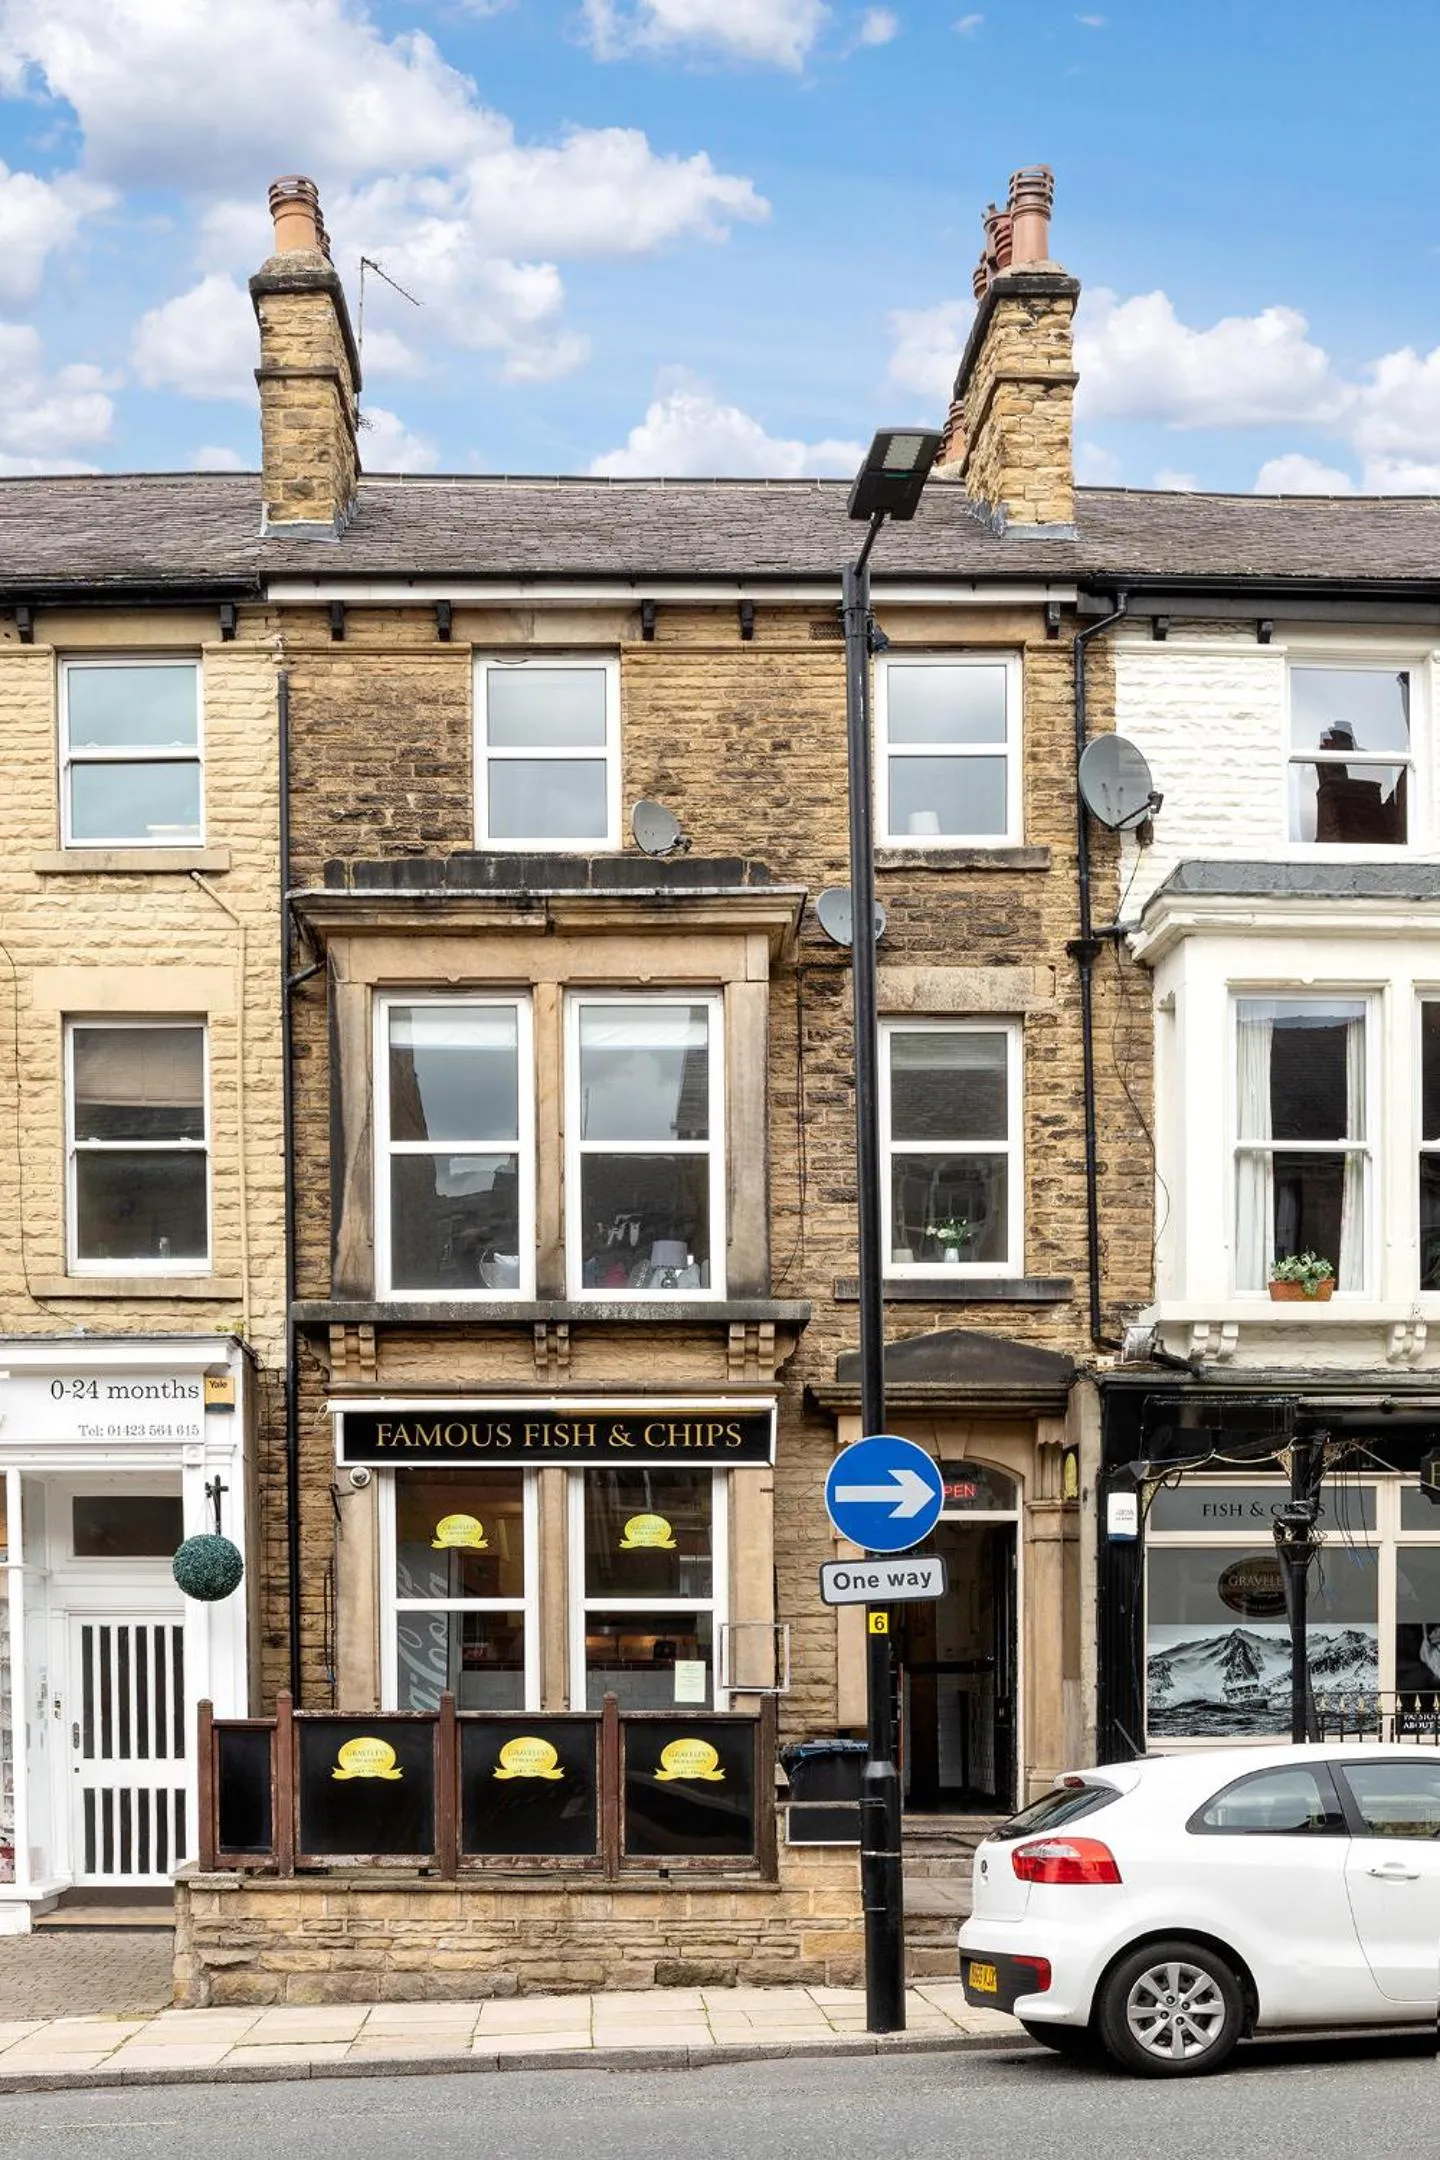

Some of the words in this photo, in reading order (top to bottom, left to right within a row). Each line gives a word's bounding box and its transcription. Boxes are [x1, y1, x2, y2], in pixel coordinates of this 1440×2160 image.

[51, 1379, 100, 1400] 0-24
[107, 1379, 200, 1400] months
[209, 1380, 228, 1389] Yale
[78, 1424, 104, 1437] Tel:
[107, 1424, 146, 1437] 01423
[375, 1422, 513, 1448] FAMOUS
[524, 1423, 597, 1447] FISH
[608, 1423, 637, 1447] &
[644, 1422, 742, 1448] CHIPS
[943, 1484, 976, 1498] PEN
[1202, 1503, 1242, 1517] FISH
[1250, 1501, 1265, 1517] &
[833, 1571, 880, 1591] One
[887, 1571, 932, 1588] way
[874, 1615, 886, 1631] 6
